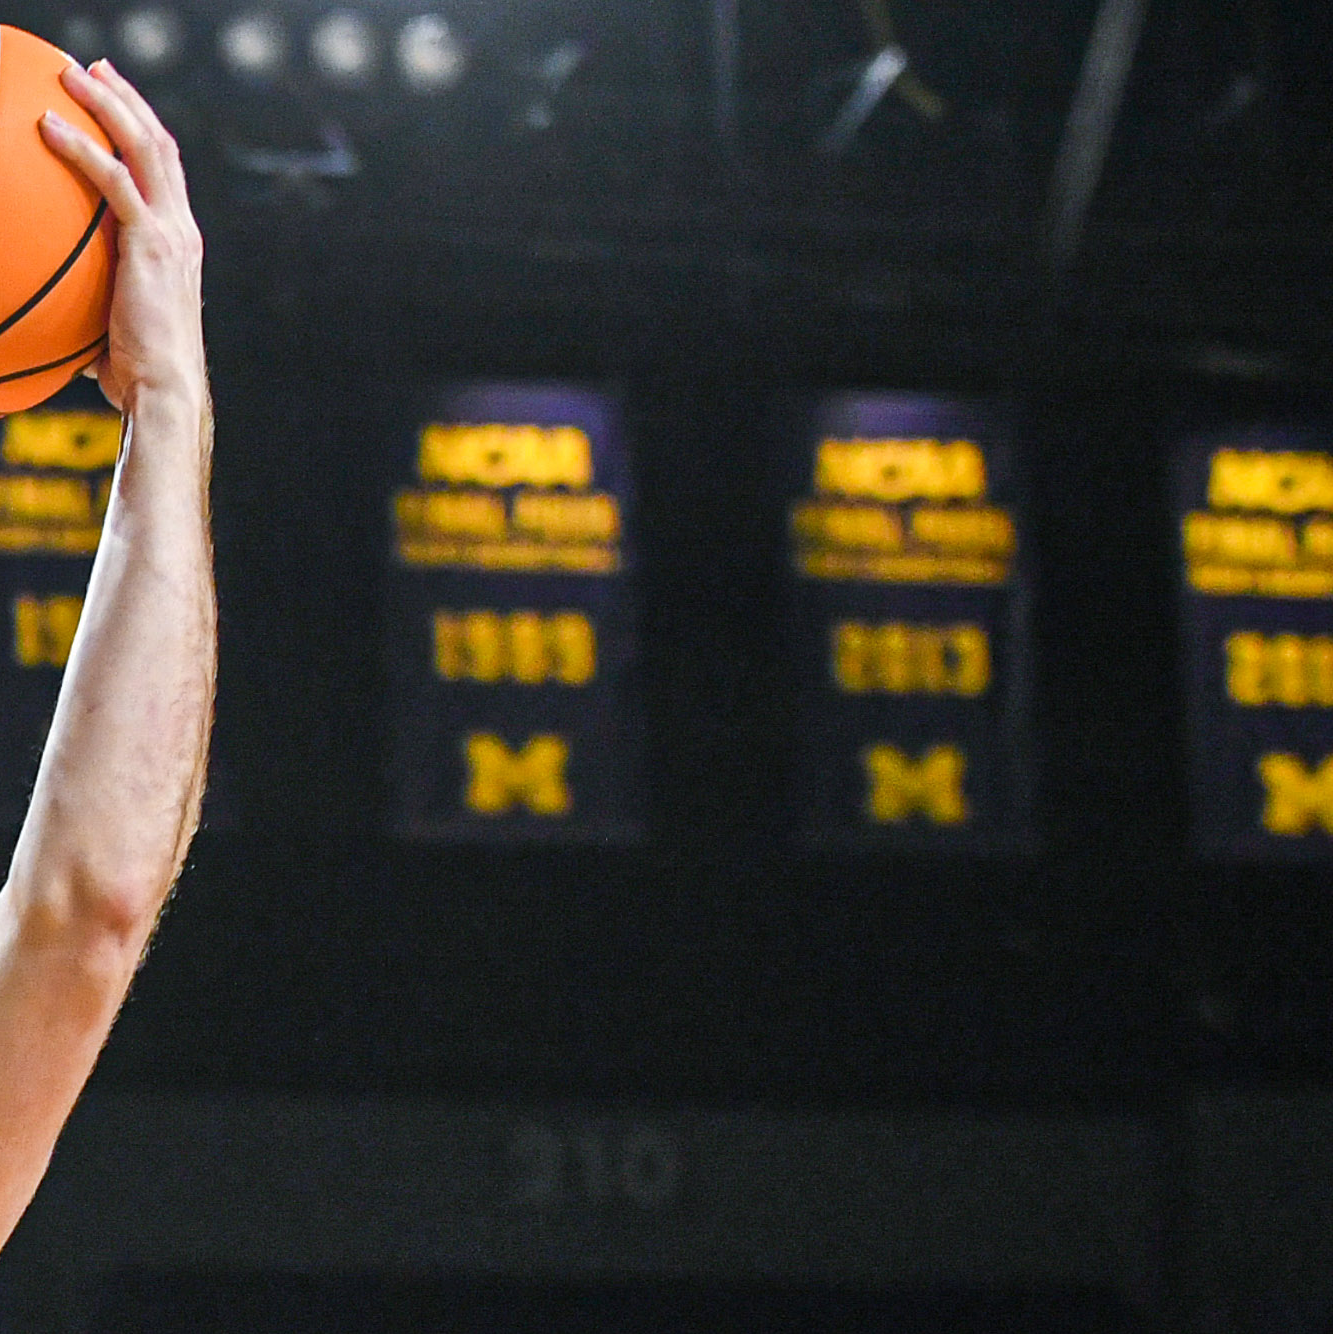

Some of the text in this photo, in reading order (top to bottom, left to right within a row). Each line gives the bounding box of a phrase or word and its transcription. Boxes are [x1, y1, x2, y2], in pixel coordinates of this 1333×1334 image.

[464, 733, 571, 815] M
[866, 745, 967, 823] M
[1257, 752, 1333, 835] M
